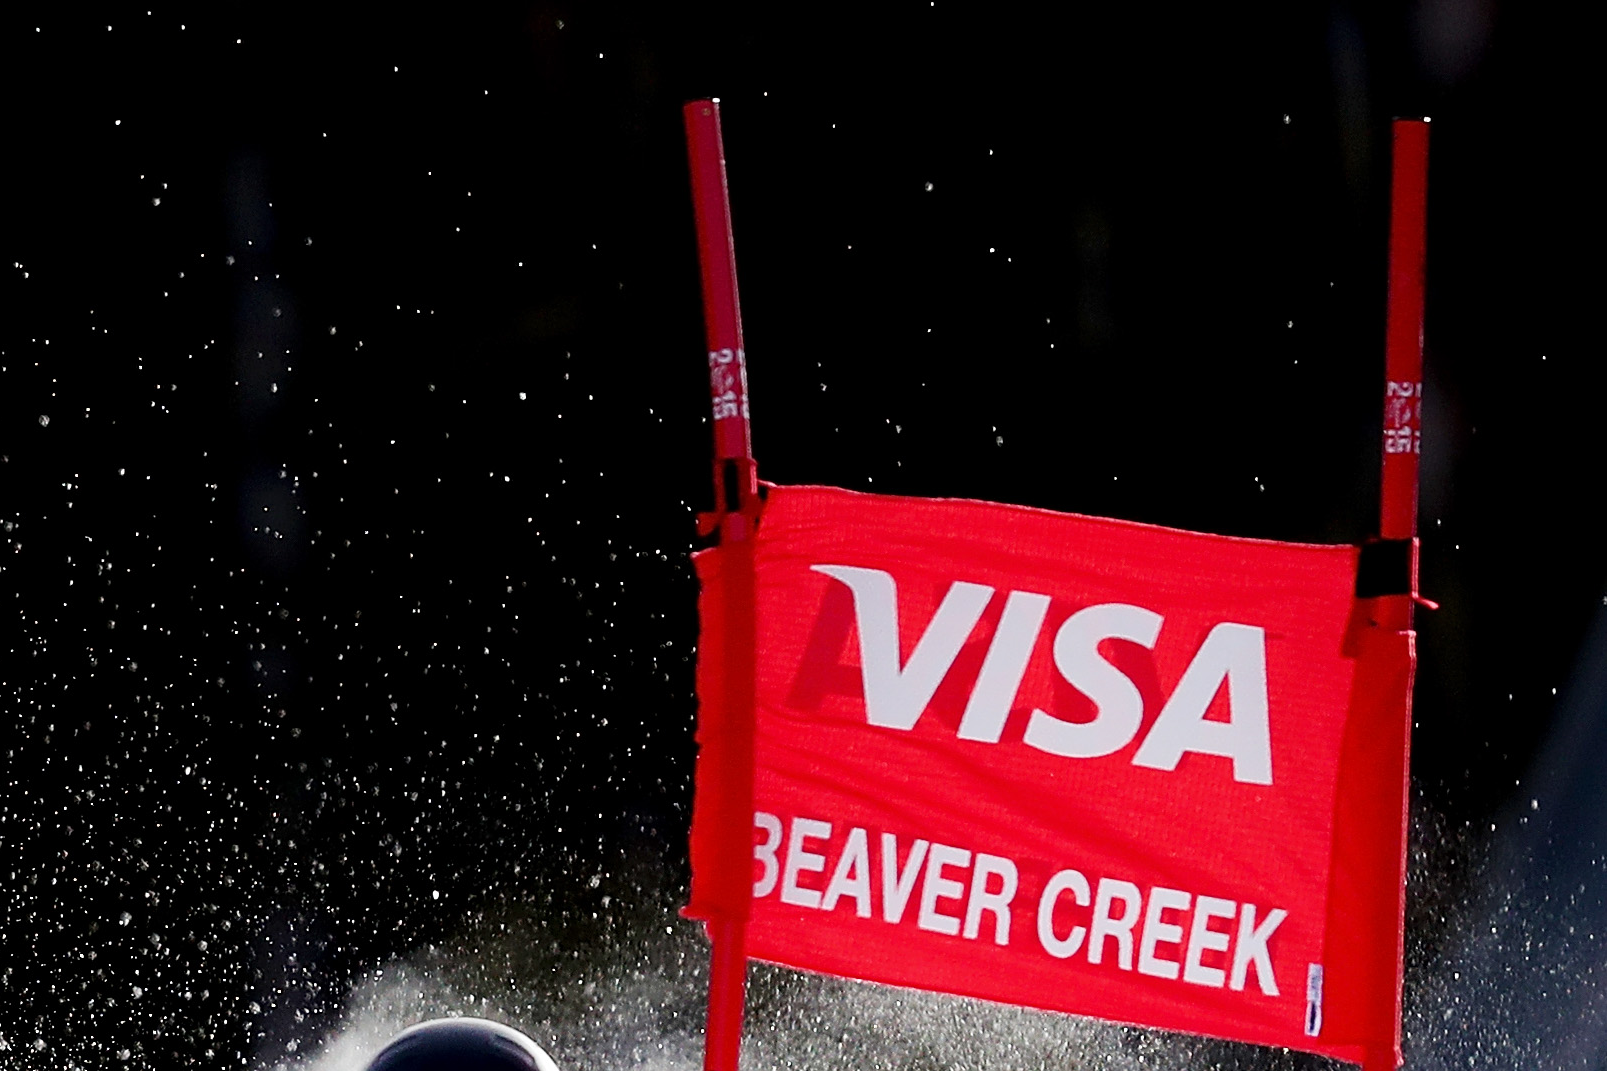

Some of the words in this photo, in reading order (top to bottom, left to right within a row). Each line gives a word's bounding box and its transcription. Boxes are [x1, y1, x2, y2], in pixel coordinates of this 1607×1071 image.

[810, 564, 1273, 786] VISA
[753, 811, 1019, 946] BEAVER
[1036, 870, 1288, 996] CREEK
